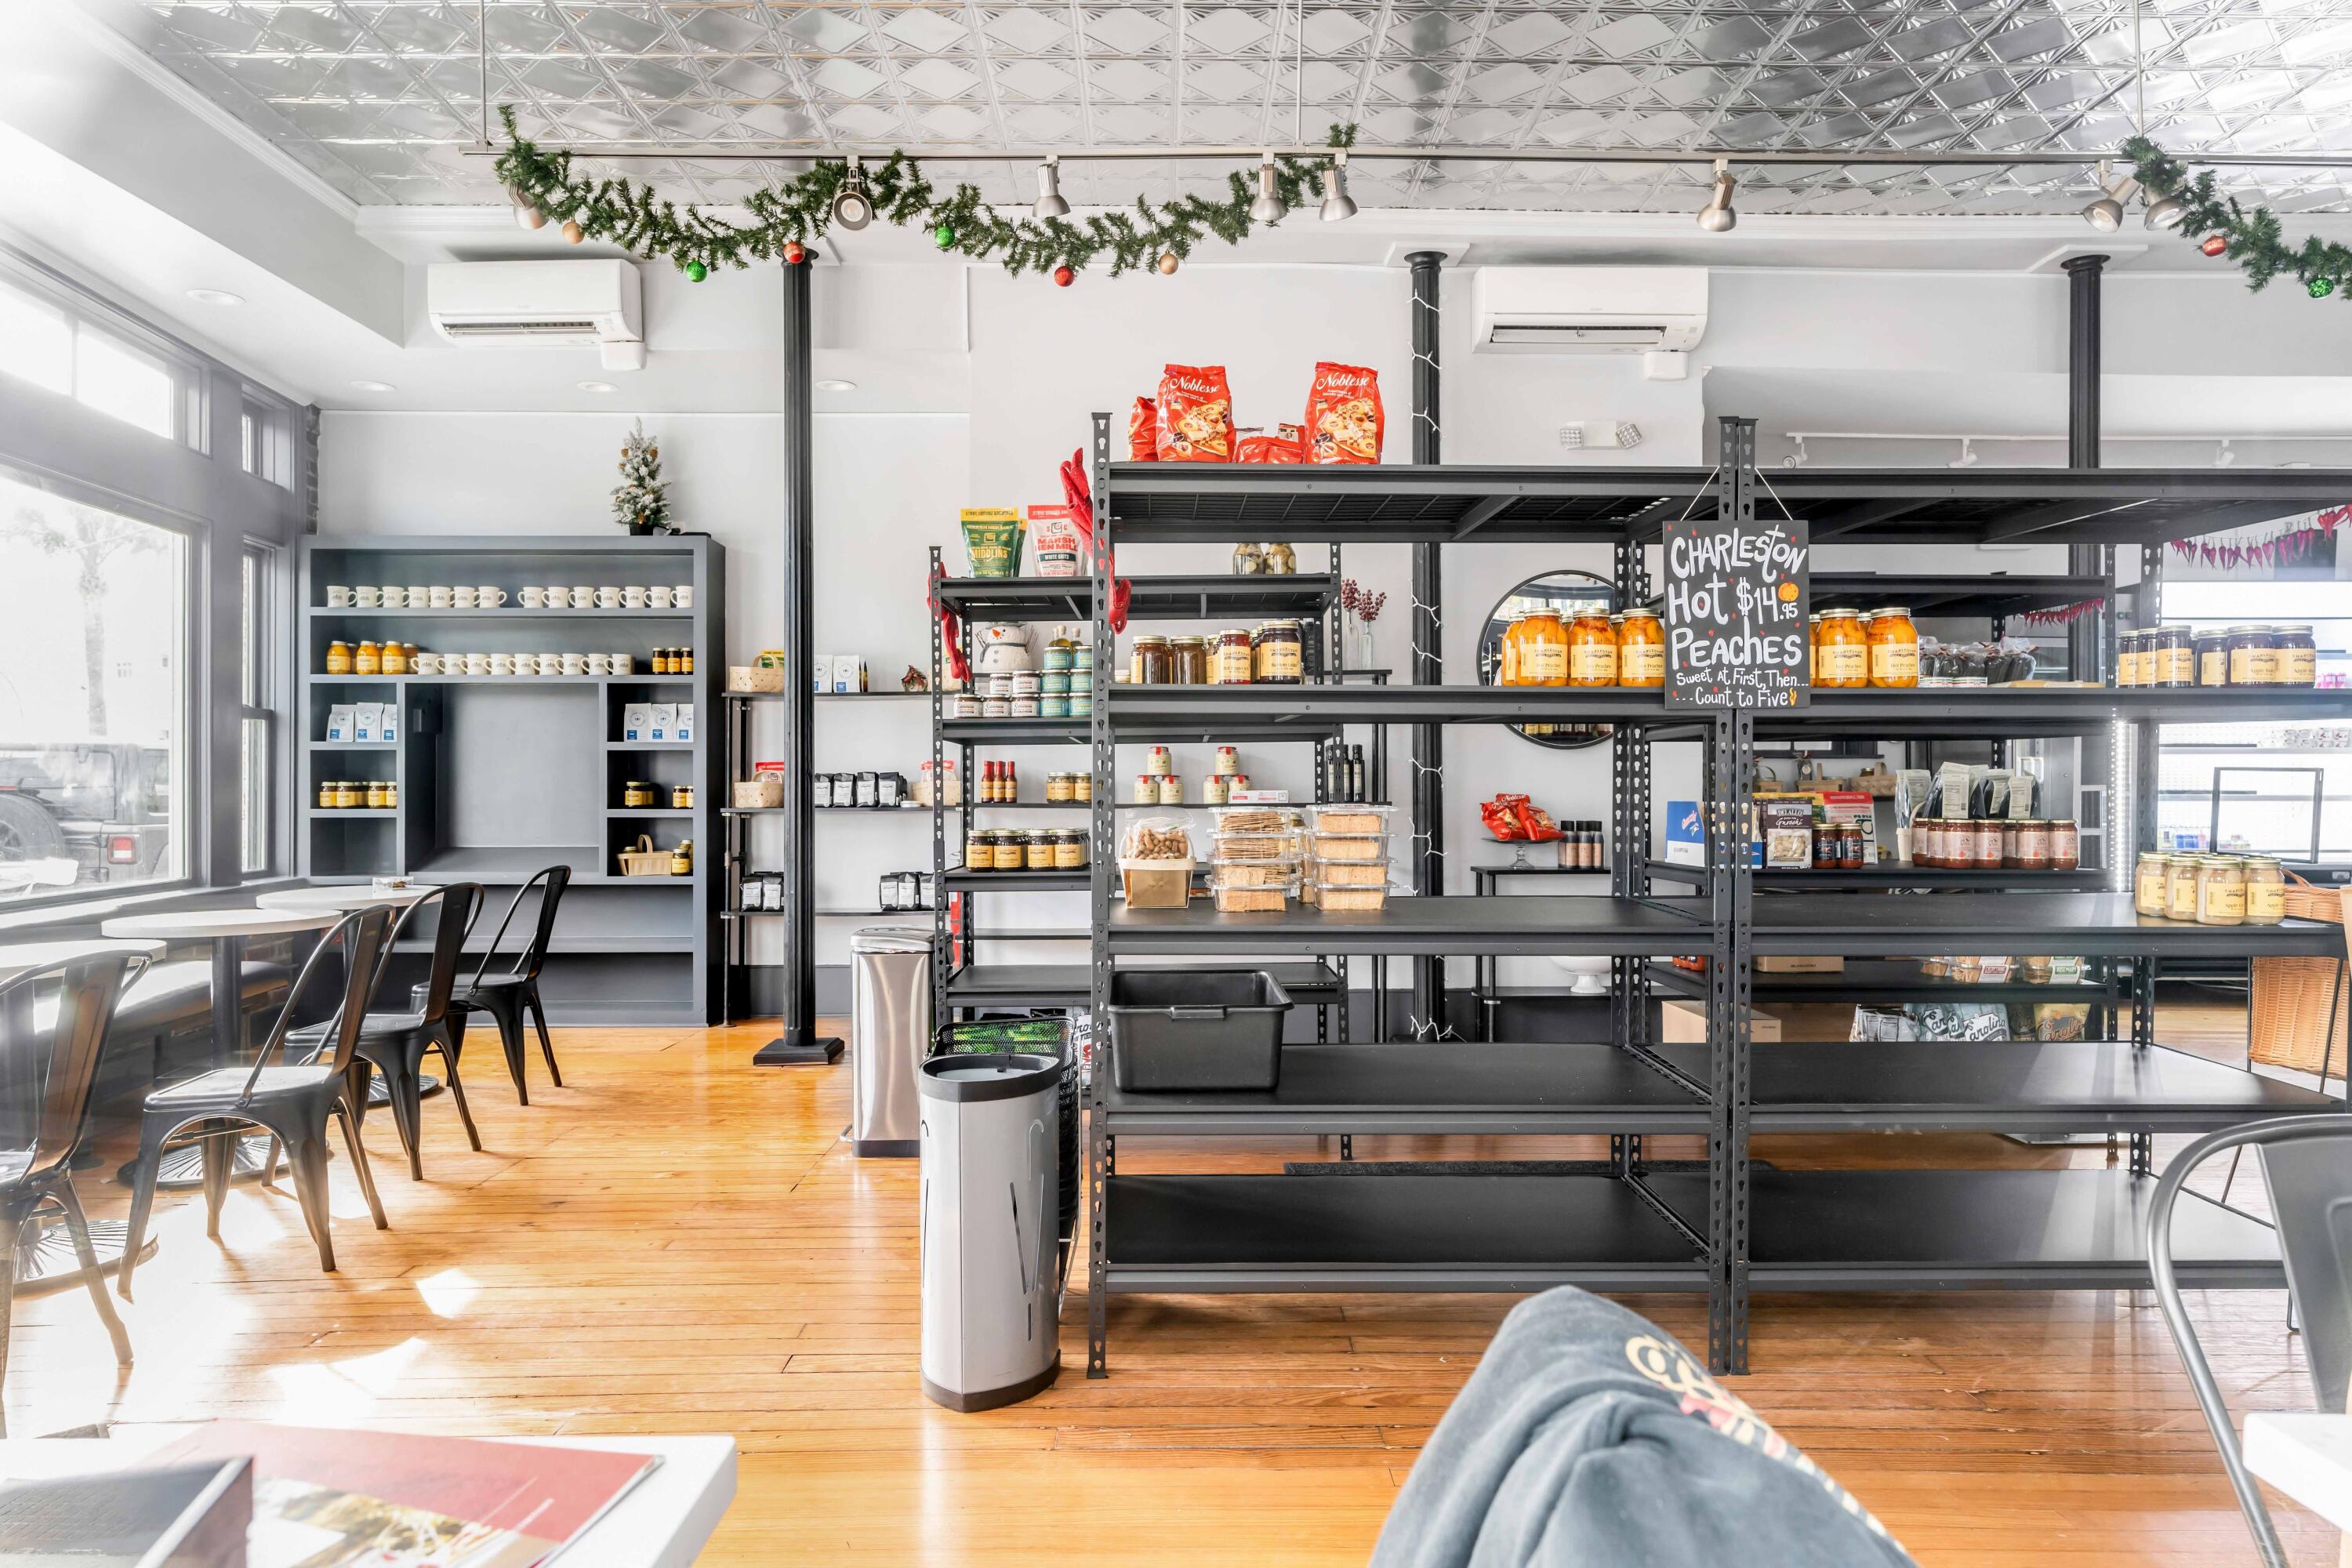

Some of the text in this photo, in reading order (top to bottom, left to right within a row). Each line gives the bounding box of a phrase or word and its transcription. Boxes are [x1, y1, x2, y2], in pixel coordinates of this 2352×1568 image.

[1170, 376, 1219, 393] Noblesse
[1316, 372, 1370, 390] Noblesse
[971, 549, 1008, 559] MIDDLINS
[1668, 572, 1729, 625] Hot
[1676, 666, 1713, 686] Sweet
[1717, 666, 1730, 685] At
[1736, 688, 1753, 706] to
[1758, 689, 1788, 707] Five
